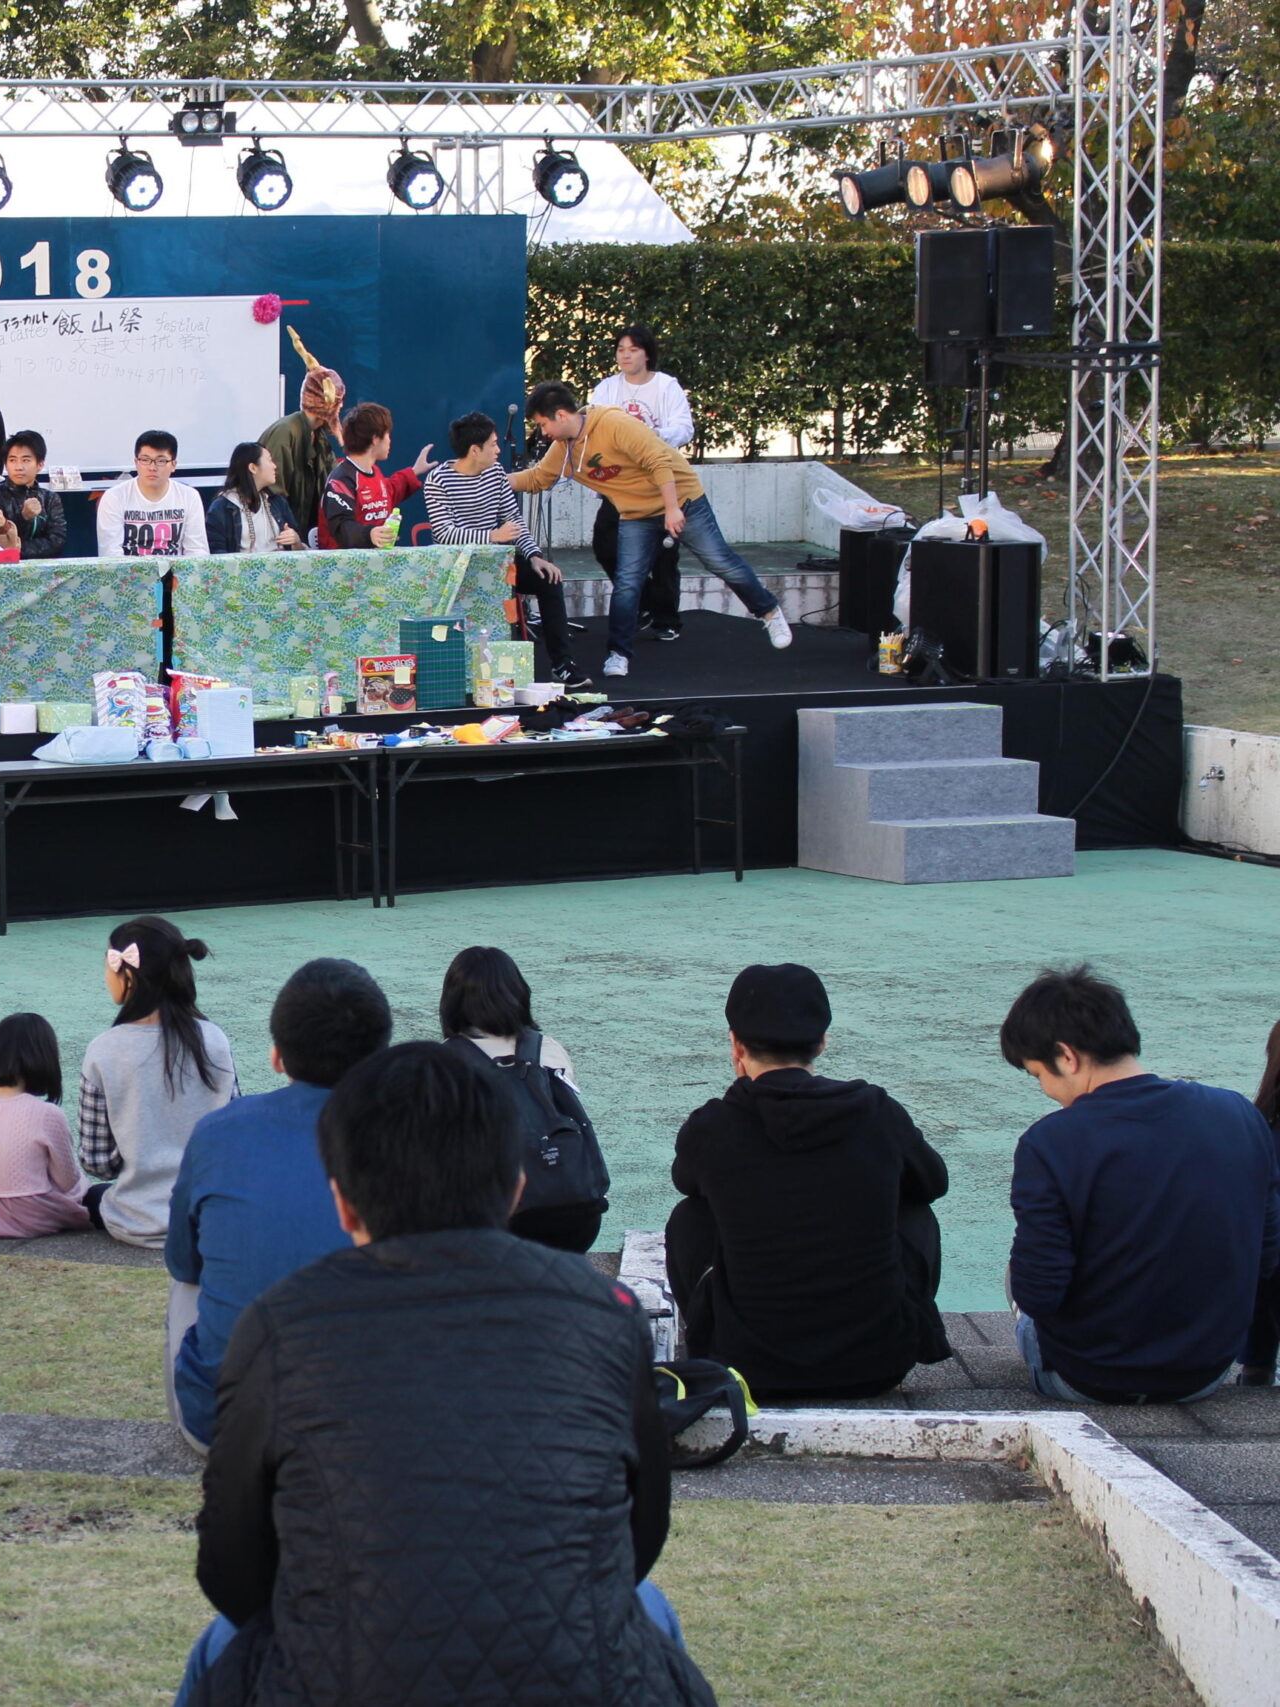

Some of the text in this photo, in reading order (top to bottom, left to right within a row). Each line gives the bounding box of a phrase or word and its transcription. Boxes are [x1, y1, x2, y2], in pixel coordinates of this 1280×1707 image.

[52, 307, 143, 336] 飯山祭
[124, 508, 185, 521] WORLD WITH MUSIC
